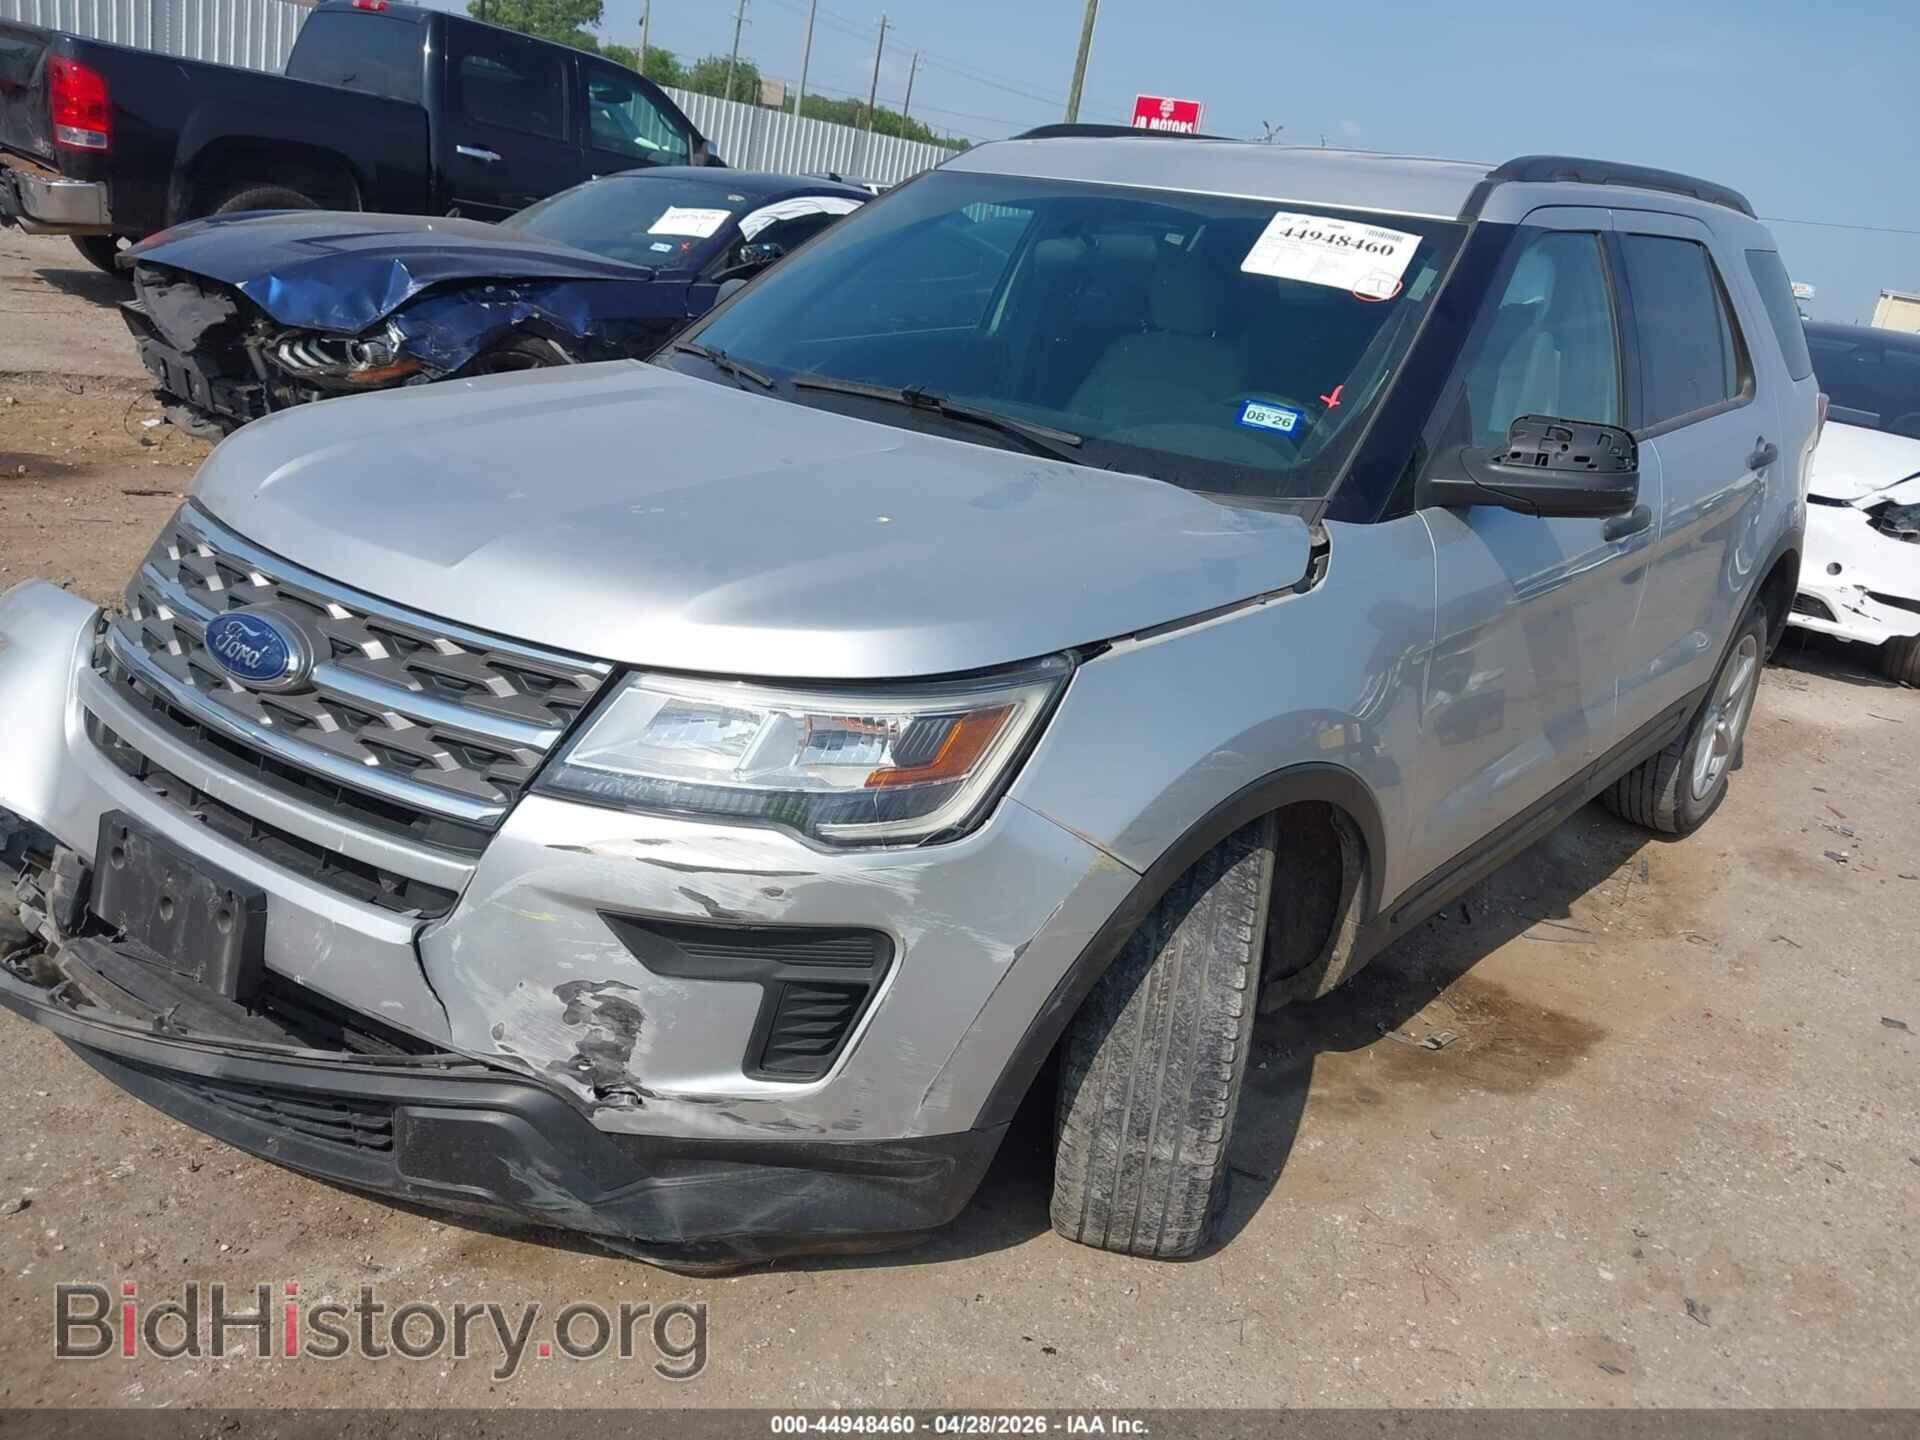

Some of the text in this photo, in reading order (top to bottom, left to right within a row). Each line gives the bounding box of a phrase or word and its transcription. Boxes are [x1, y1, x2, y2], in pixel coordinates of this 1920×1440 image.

[1150, 117, 1194, 134] MOTORS
[1279, 226, 1395, 257] 44948460
[1246, 410, 1266, 422] 08
[1272, 417, 1292, 428] 26
[215, 620, 269, 669] Ford
